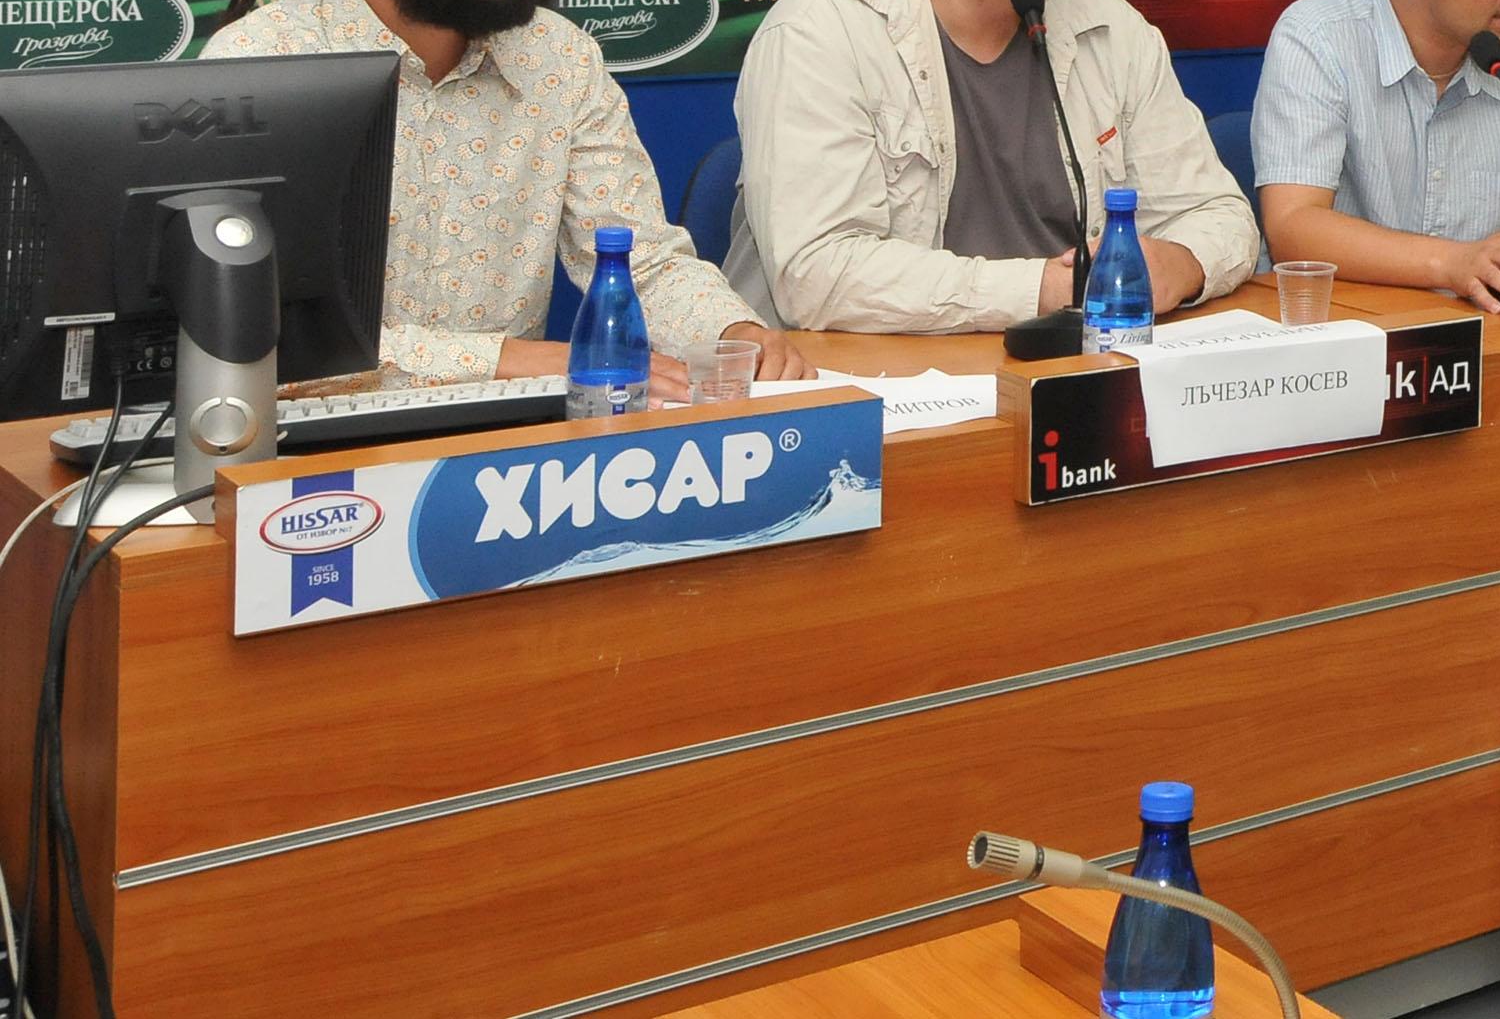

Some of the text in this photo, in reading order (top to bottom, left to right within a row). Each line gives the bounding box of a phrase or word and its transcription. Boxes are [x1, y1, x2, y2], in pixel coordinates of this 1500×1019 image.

[134, 96, 271, 145] DELL
[1181, 370, 1349, 408] ЛЪЧЕЗАР КОСЕВ
[1429, 361, 1471, 396] АД
[474, 431, 774, 543] ХИСАР
[1061, 461, 1118, 489] bank
[281, 503, 359, 536] HISSAR
[308, 571, 340, 586] 1958
